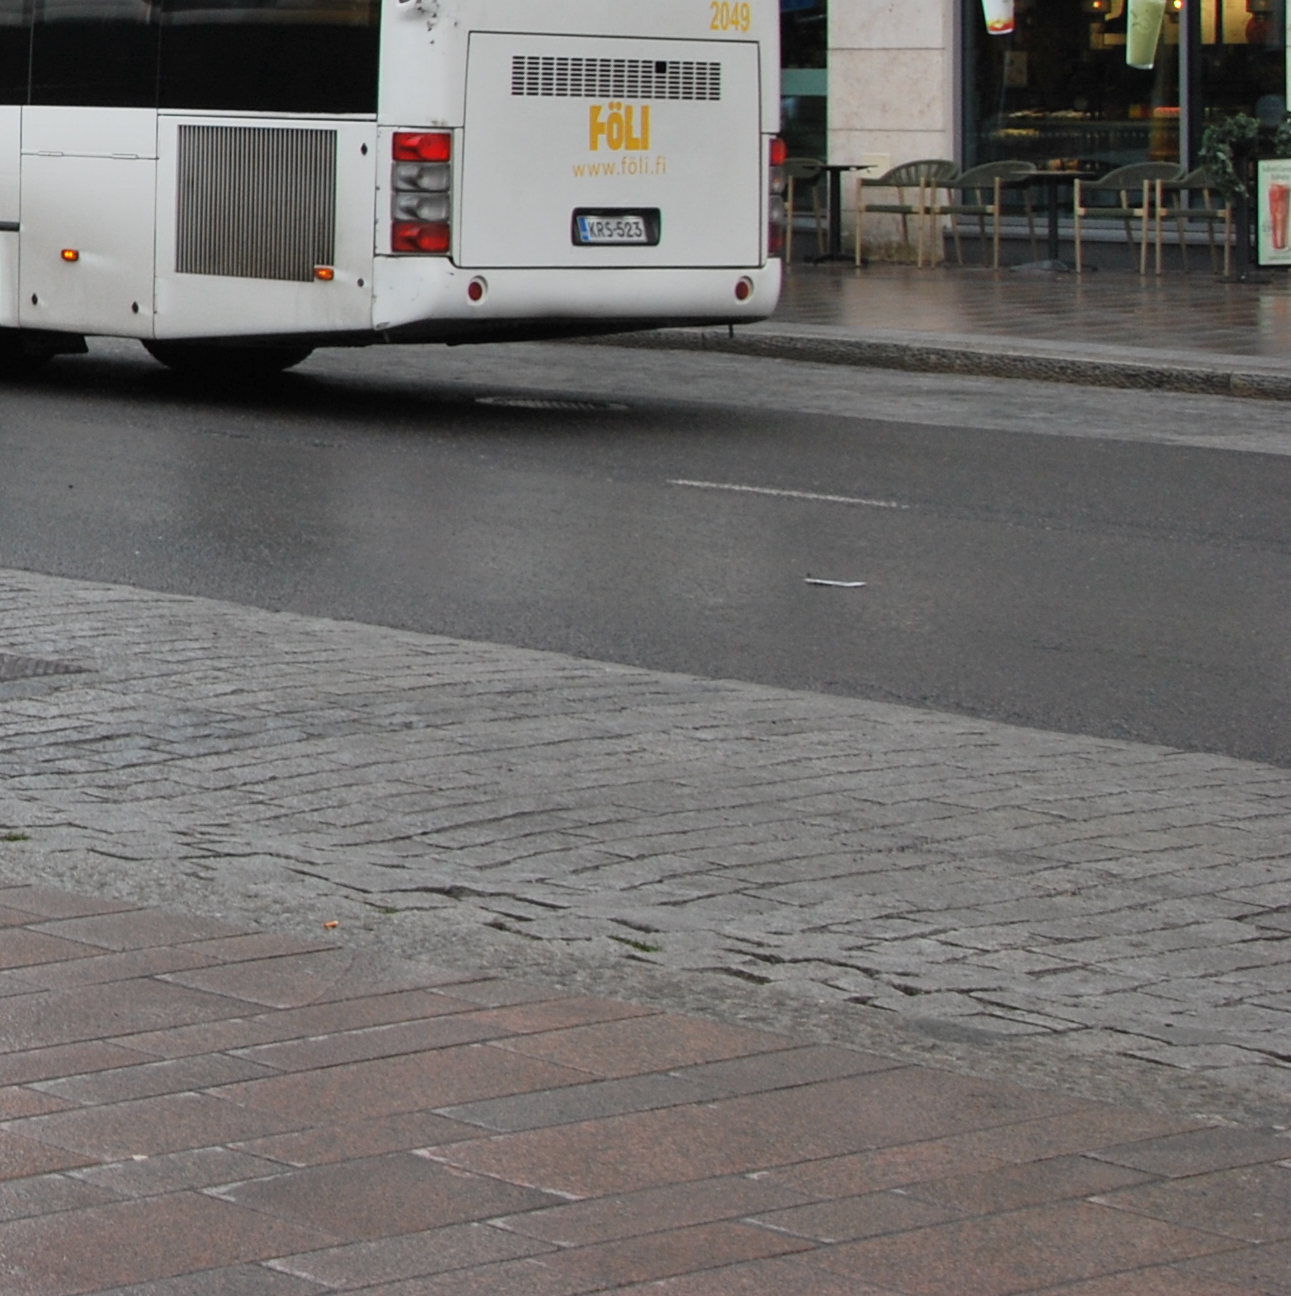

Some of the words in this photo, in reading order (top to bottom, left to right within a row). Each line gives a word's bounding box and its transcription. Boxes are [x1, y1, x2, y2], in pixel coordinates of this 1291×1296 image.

[710, 1, 751, 32] 2049
[589, 101, 650, 151] FÖLI
[573, 156, 667, 177] www.föli.fi
[589, 220, 644, 238] KRS-523
